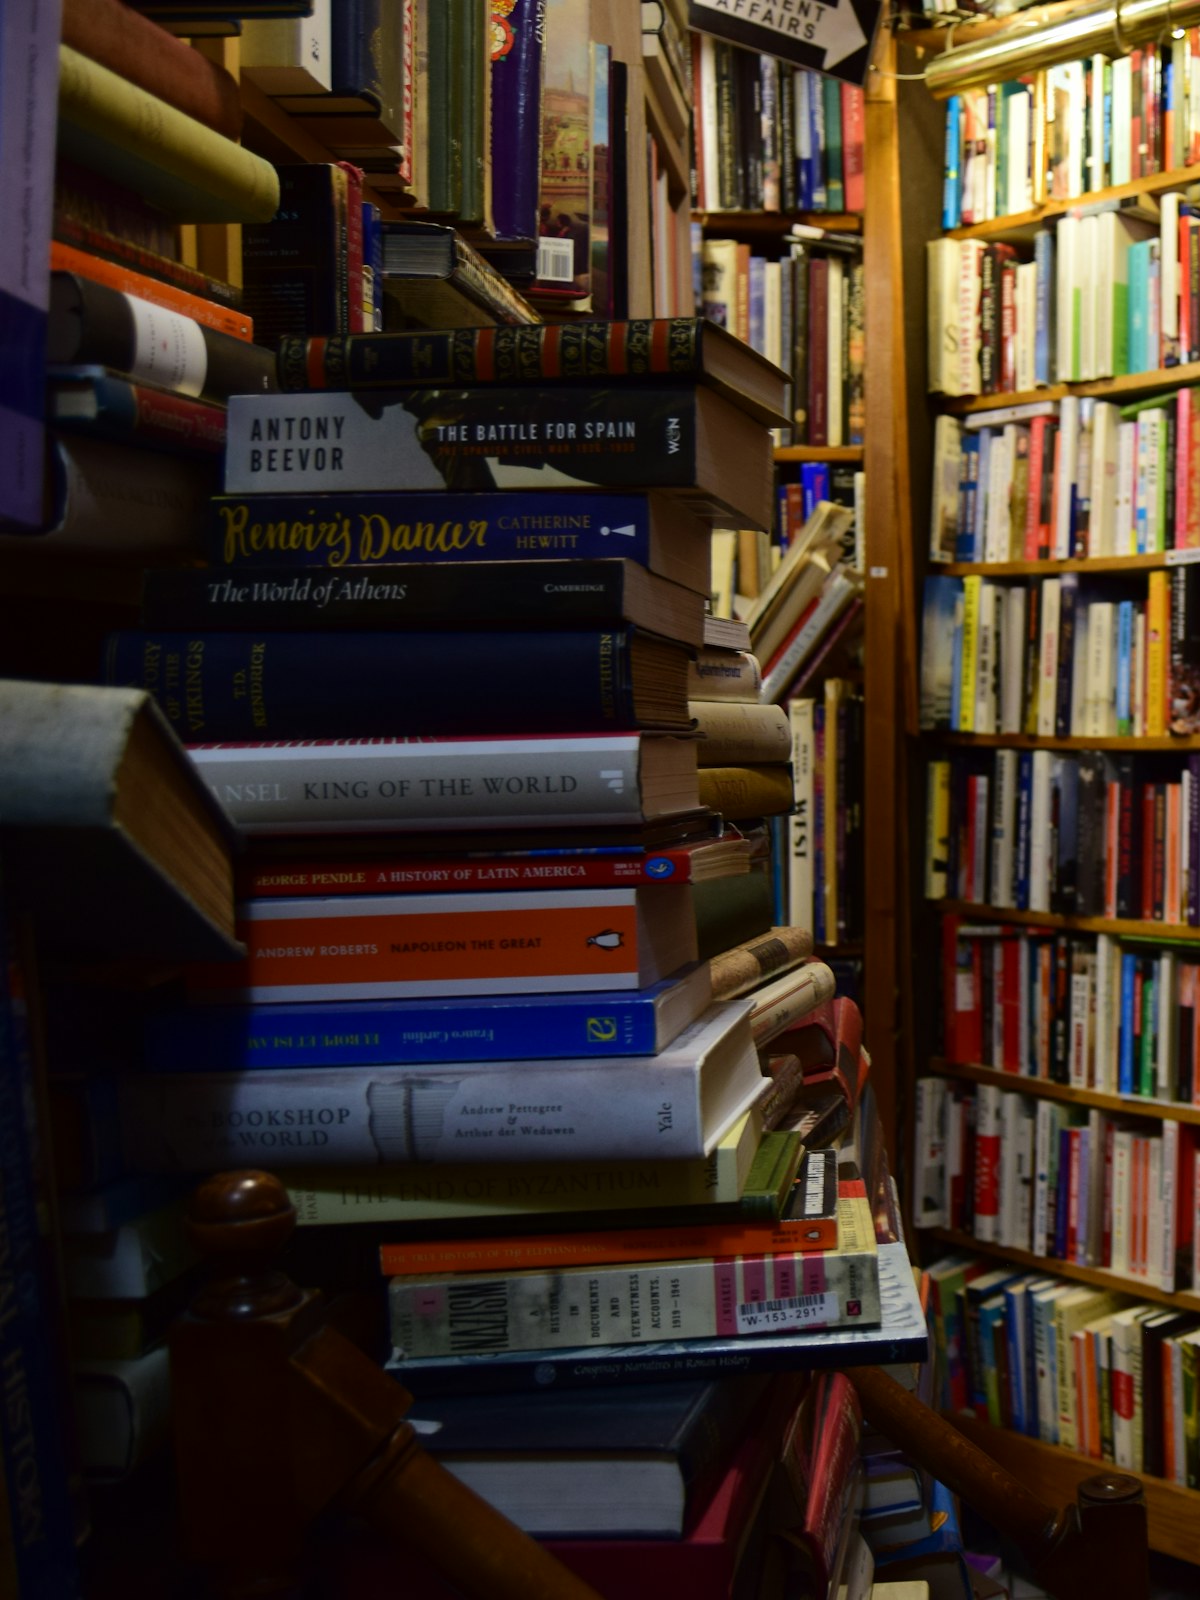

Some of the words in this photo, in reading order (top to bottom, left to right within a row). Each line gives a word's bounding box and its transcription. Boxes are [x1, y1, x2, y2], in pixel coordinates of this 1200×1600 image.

[715, 0, 816, 40] AFFAIRS
[249, 415, 346, 442] ANTONY
[437, 424, 472, 443] THE
[476, 423, 540, 442] BATTLE
[546, 422, 579, 440] FOR
[584, 420, 637, 440] SPAIN
[249, 447, 345, 473] BEEVOR
[461, 445, 509, 457] SPANISH
[511, 444, 543, 456] CIVIL
[219, 504, 351, 566] Renoir's
[357, 513, 489, 560] Dancer
[499, 514, 592, 533] CATHERINE
[515, 532, 579, 550] HEWITT
[207, 581, 249, 603] The
[250, 580, 311, 603] World
[312, 580, 338, 608] of
[339, 579, 408, 602] Athens
[543, 582, 606, 594] CAMBRIDGE
[164, 653, 179, 690] THE
[233, 668, 247, 700] T.D.
[599, 632, 615, 720] METHUEN
[185, 639, 206, 732] VIKINGS
[249, 641, 267, 729] KENDRICK
[165, 695, 181, 720] OF
[210, 781, 288, 803] ANSEL
[302, 780, 370, 801] KING
[378, 778, 412, 799] OF
[418, 777, 475, 798] THE
[481, 774, 579, 796] WORLD
[251, 872, 306, 888] GEORGE
[309, 870, 367, 886] PENDLE
[376, 870, 387, 883] A
[389, 867, 452, 883] HISTORY
[454, 867, 474, 881] OF
[476, 866, 519, 881] LATIN
[521, 864, 587, 880] AMERICA
[255, 944, 316, 960] ANDREW
[319, 942, 379, 957] ROBERTS
[390, 939, 468, 954] NAPOLEON
[471, 938, 496, 952] THE
[499, 936, 543, 951] GREAT
[401, 1029, 449, 1046] Cardini
[450, 1028, 495, 1044] Franco
[212, 1108, 351, 1128] BOOKSHOP
[460, 1105, 504, 1117] Andrew
[508, 1103, 563, 1117] Pettegree
[657, 1102, 673, 1134] Yale
[237, 1130, 330, 1148] WORLD
[454, 1127, 496, 1139] Arthur
[499, 1126, 515, 1138] der
[517, 1124, 576, 1137] Weduwen
[339, 1181, 392, 1205] THE
[398, 1179, 449, 1203] END
[456, 1178, 498, 1200] OF
[506, 1169, 660, 1200] BYZANTIUM
[704, 1157, 718, 1191] Yale
[610, 1297, 620, 1318] AND
[630, 1274, 640, 1338] EYEWITNESS
[650, 1275, 661, 1329] ACCOUNTS.
[752, 1288, 761, 1302] ND
[448, 1280, 509, 1351] NAZISM
[530, 1309, 539, 1317] A
[551, 1291, 561, 1334] HISTORY
[569, 1304, 580, 1316] IN
[590, 1279, 600, 1338] DOCUMENTS
[674, 1360, 684, 1370] in
[720, 1354, 751, 1369] History
[3, 1350, 47, 1550] HISTORY
